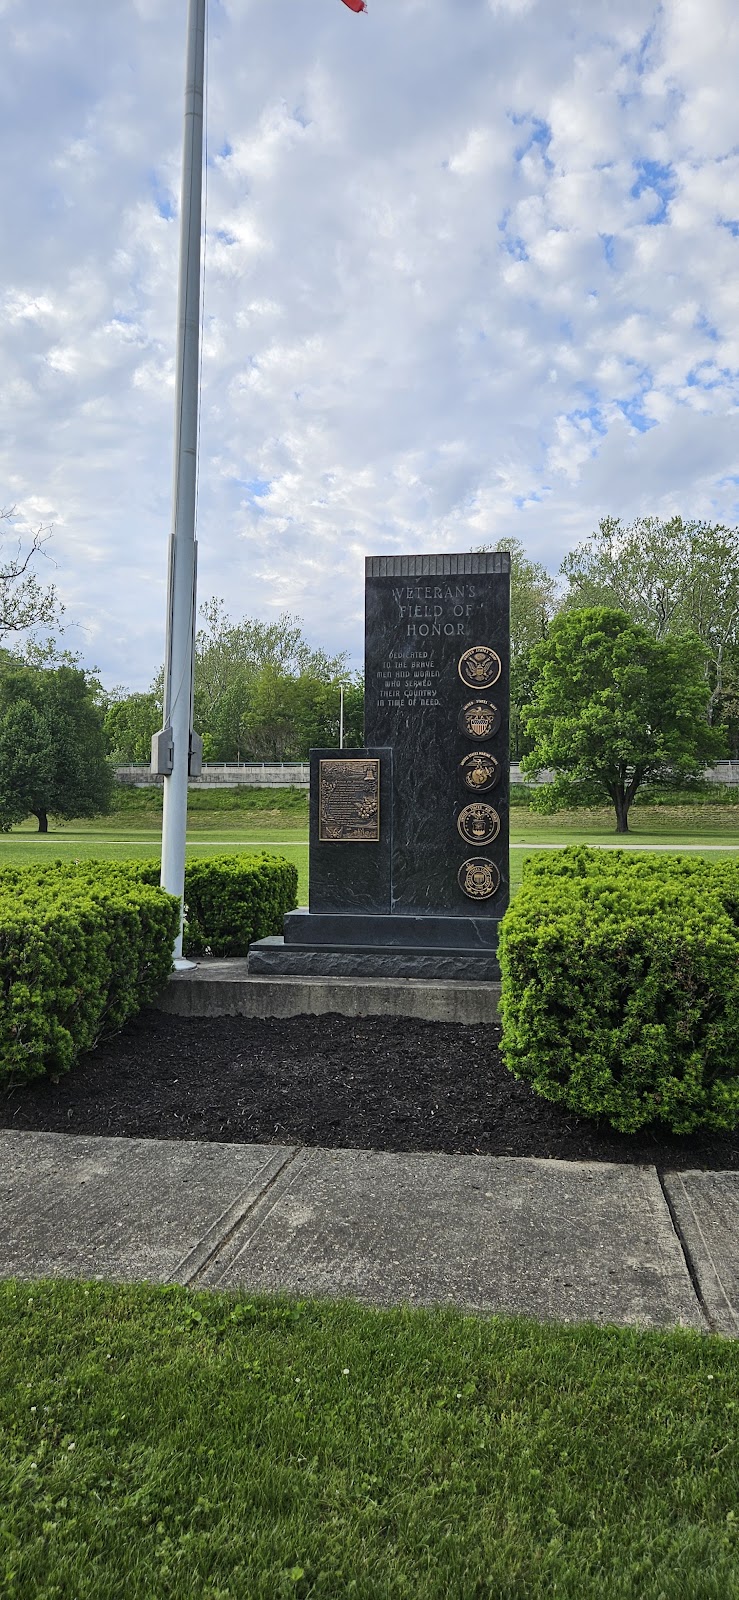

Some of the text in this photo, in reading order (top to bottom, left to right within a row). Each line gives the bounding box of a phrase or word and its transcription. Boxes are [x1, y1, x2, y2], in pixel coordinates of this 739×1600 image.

[393, 585, 476, 598] VETERAN'S
[400, 604, 472, 618] FIELD OF
[407, 623, 465, 636] HONOR
[389, 651, 428, 659] DEDICATED
[383, 660, 435, 669] TO THE BRAVE
[413, 670, 440, 678] WOMEN
[384, 679, 432, 688] WHO SERVED
[403, 689, 437, 697] COUNTRY
[377, 699, 385, 707] IN
[387, 699, 405, 707] TIME
